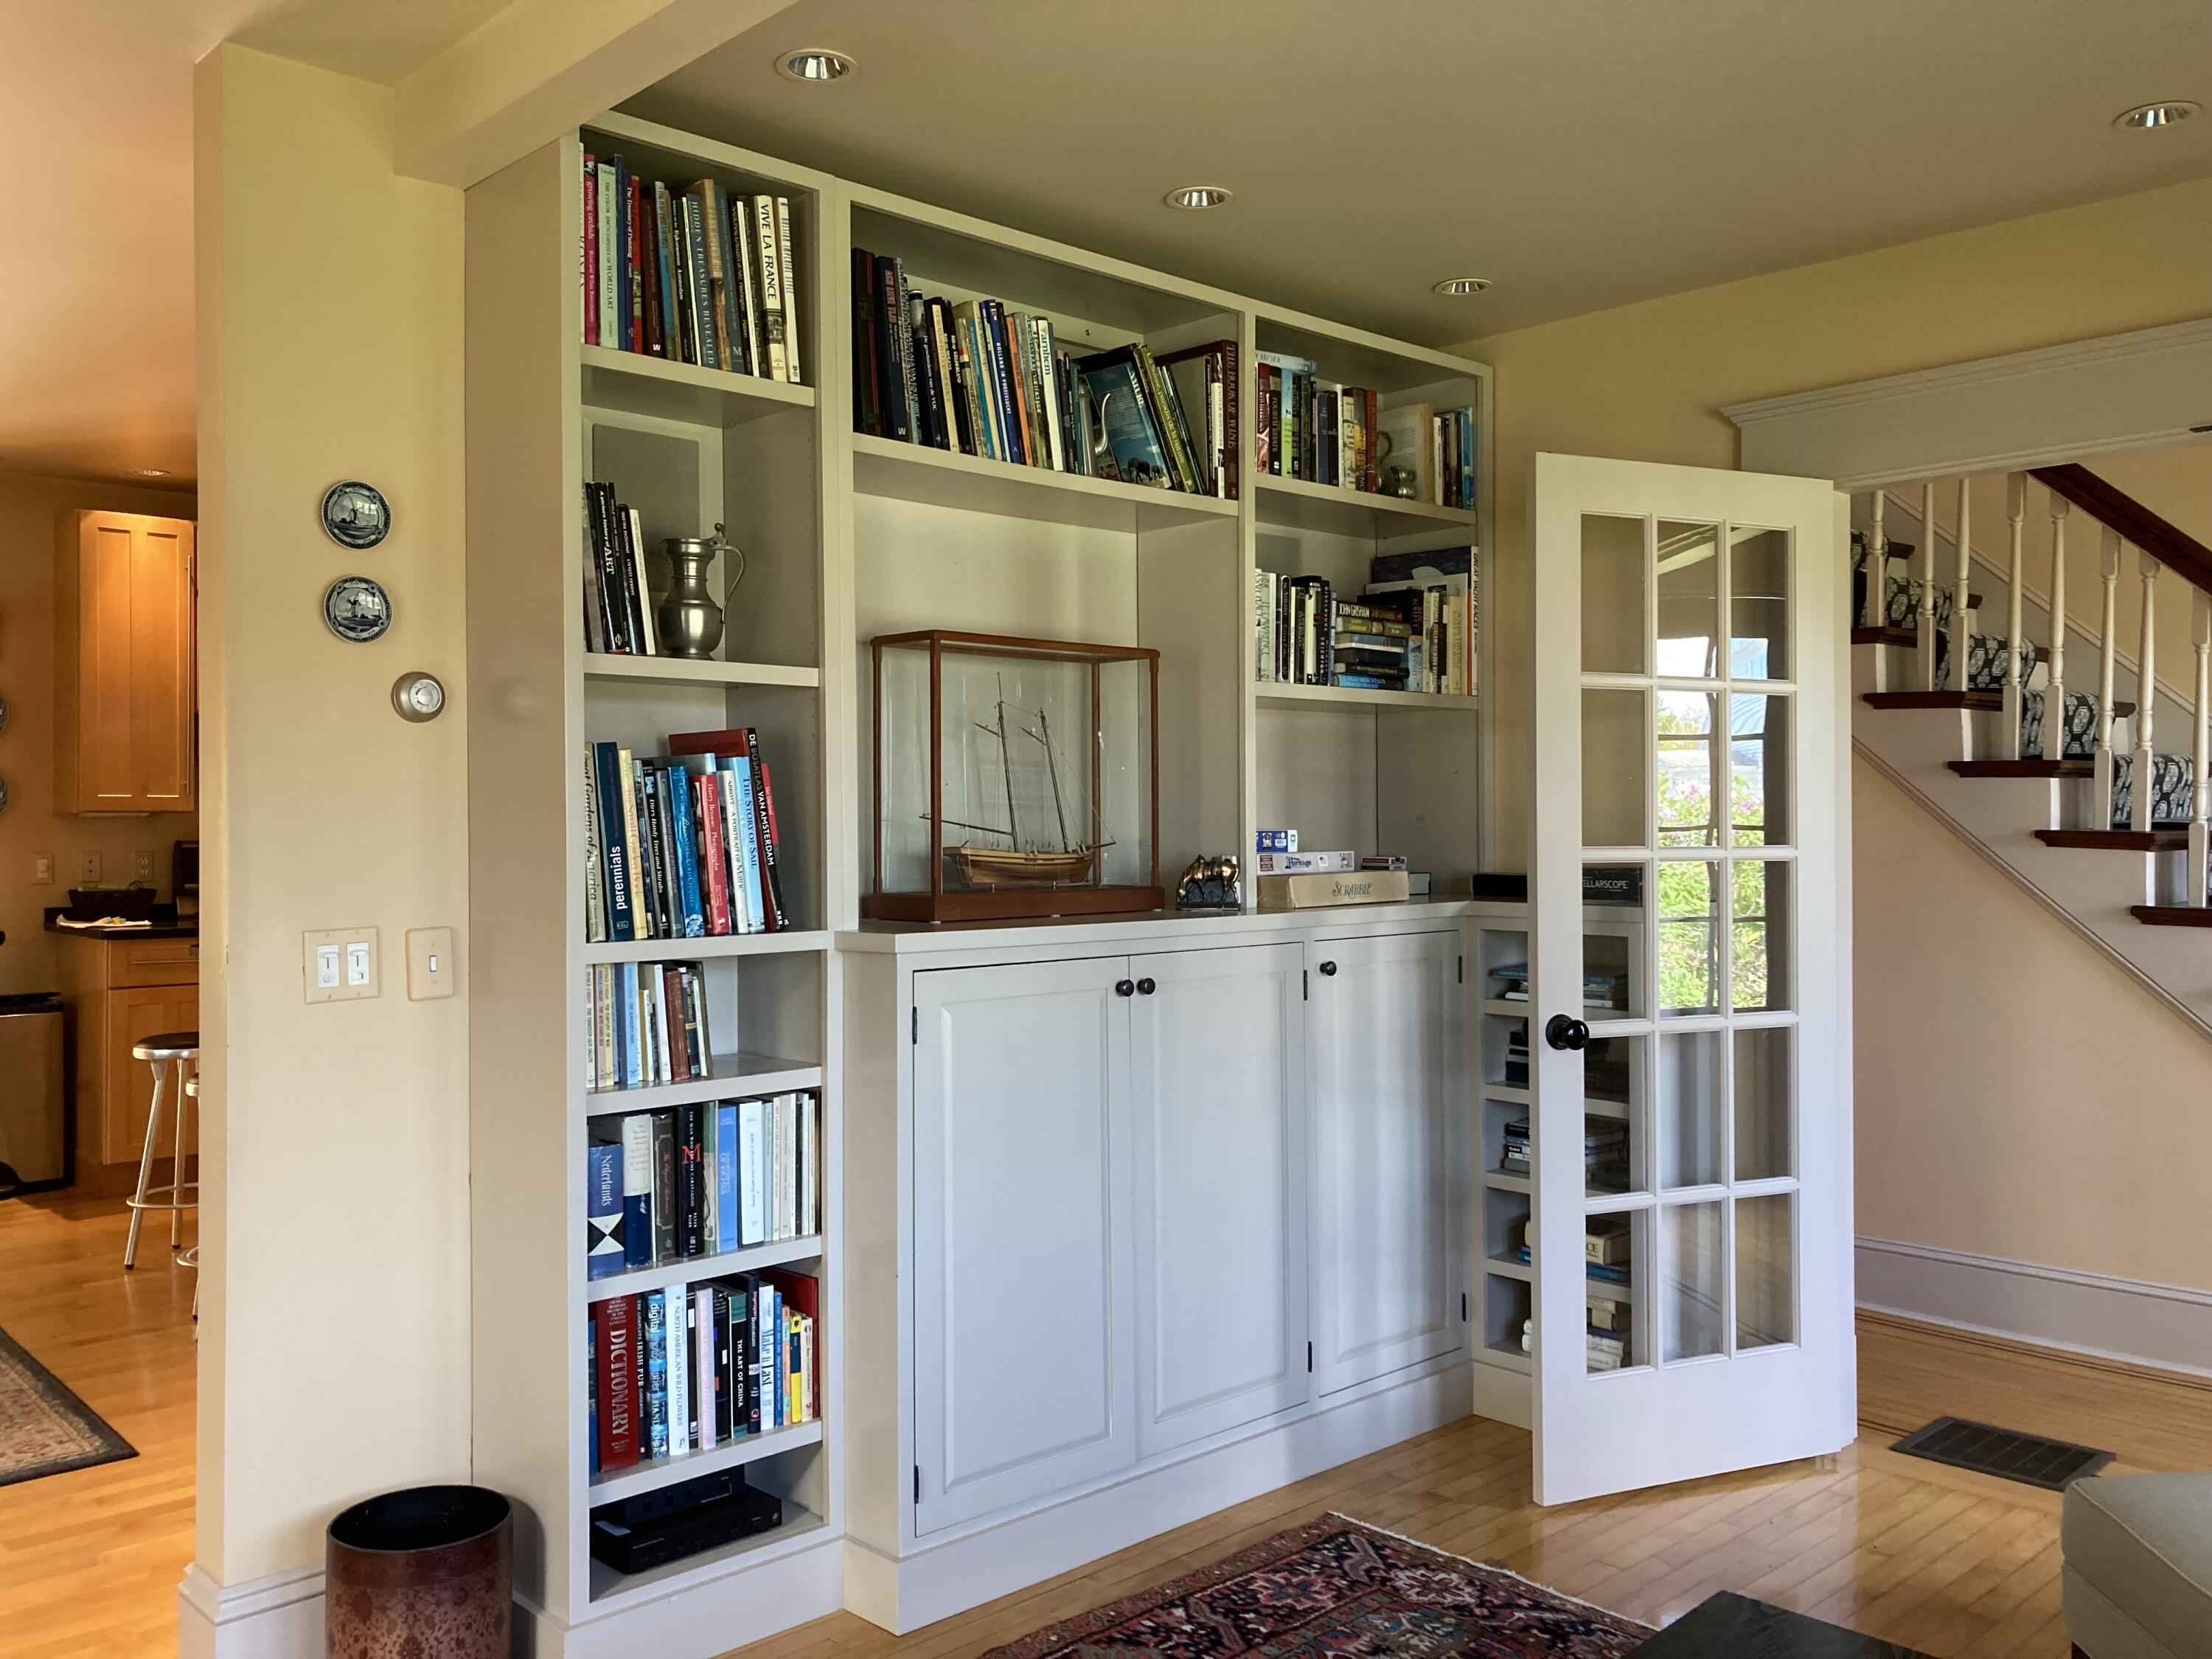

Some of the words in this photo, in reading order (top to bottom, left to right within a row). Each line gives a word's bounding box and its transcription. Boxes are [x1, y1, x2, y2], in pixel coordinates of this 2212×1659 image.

[586, 181, 595, 212] growing
[586, 212, 596, 239] orchids
[625, 199, 633, 226] Treasury
[691, 201, 702, 242] HIDDEN
[760, 204, 771, 230] VIVE
[763, 235, 772, 249] LA
[606, 265, 614, 293] WORLD
[696, 247, 709, 306] TREASURES
[765, 255, 777, 300] FRANCE
[703, 310, 714, 364] REVEALED
[923, 344, 933, 378] geschiedenis
[953, 351, 961, 383] GELDERLAND
[1040, 333, 1051, 375] arnhem
[1146, 352, 1155, 366] La
[1225, 344, 1237, 369] THE
[996, 341, 1005, 369] HOLLAND
[1001, 378, 1011, 414] VOGELVLUCHT
[1227, 370, 1237, 400] BOOK
[1157, 391, 1171, 420] paradis
[1228, 401, 1237, 414] OF
[1166, 420, 1175, 431] de
[1172, 431, 1179, 439] la
[1227, 419, 1237, 450] WINE
[1172, 439, 1186, 465] nature
[1357, 448, 1367, 491] INFERNO
[599, 496, 608, 518] picture
[601, 519, 609, 540] history
[603, 546, 615, 574] ART
[1338, 603, 1351, 615] JOHN
[1351, 605, 1370, 618] GRISHAM
[1261, 613, 1270, 656] LAWRENCE
[748, 734, 757, 746] DE
[749, 748, 764, 793] BOSATLAS
[727, 779, 736, 806] ABBOTT
[742, 776, 752, 799] THE
[757, 790, 766, 810] VAN
[585, 783, 595, 832] Gardens
[625, 804, 638, 832] Small
[709, 803, 717, 827] Benson
[745, 799, 755, 831] STORY
[587, 835, 597, 849] of
[731, 817, 740, 852] PORTRAIT
[748, 832, 756, 844] OF
[759, 810, 775, 866] AMSTERDAM
[629, 834, 640, 869] Garden
[711, 831, 720, 872] Photographs
[735, 853, 742, 863] OF
[749, 845, 758, 870] SAIL
[586, 849, 600, 901] America
[610, 845, 627, 911] perennials
[633, 872, 643, 897] Book
[681, 1143, 701, 1165] M
[600, 1153, 613, 1207] Nederlands
[649, 1303, 661, 1333] digital
[636, 1341, 644, 1366] IRISH
[675, 1334, 683, 1371] AMERICAN
[761, 1329, 774, 1354] Make
[609, 1328, 630, 1436] DICTIONARY
[737, 1371, 744, 1381] OF
[761, 1364, 774, 1387] Last
[651, 1400, 661, 1455] HANDBOOK
